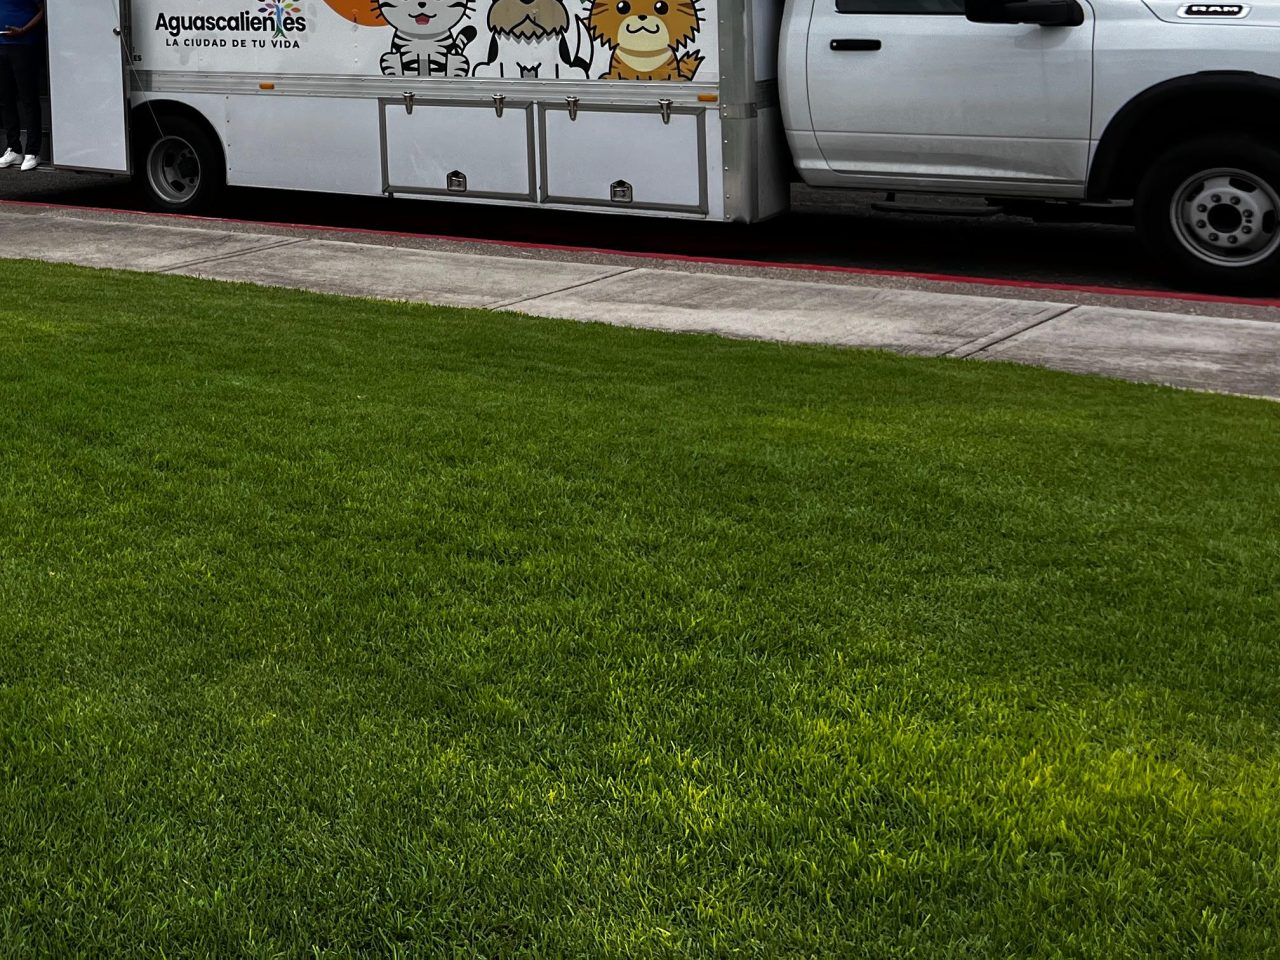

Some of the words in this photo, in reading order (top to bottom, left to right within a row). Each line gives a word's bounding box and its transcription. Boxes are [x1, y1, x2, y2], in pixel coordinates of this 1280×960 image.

[155, 8, 307, 38] Aguascalientes
[166, 38, 179, 47] LA
[183, 38, 227, 48] CIUDAD
[232, 39, 247, 48] DE
[252, 40, 266, 48] TU
[271, 40, 300, 49] VIDA
